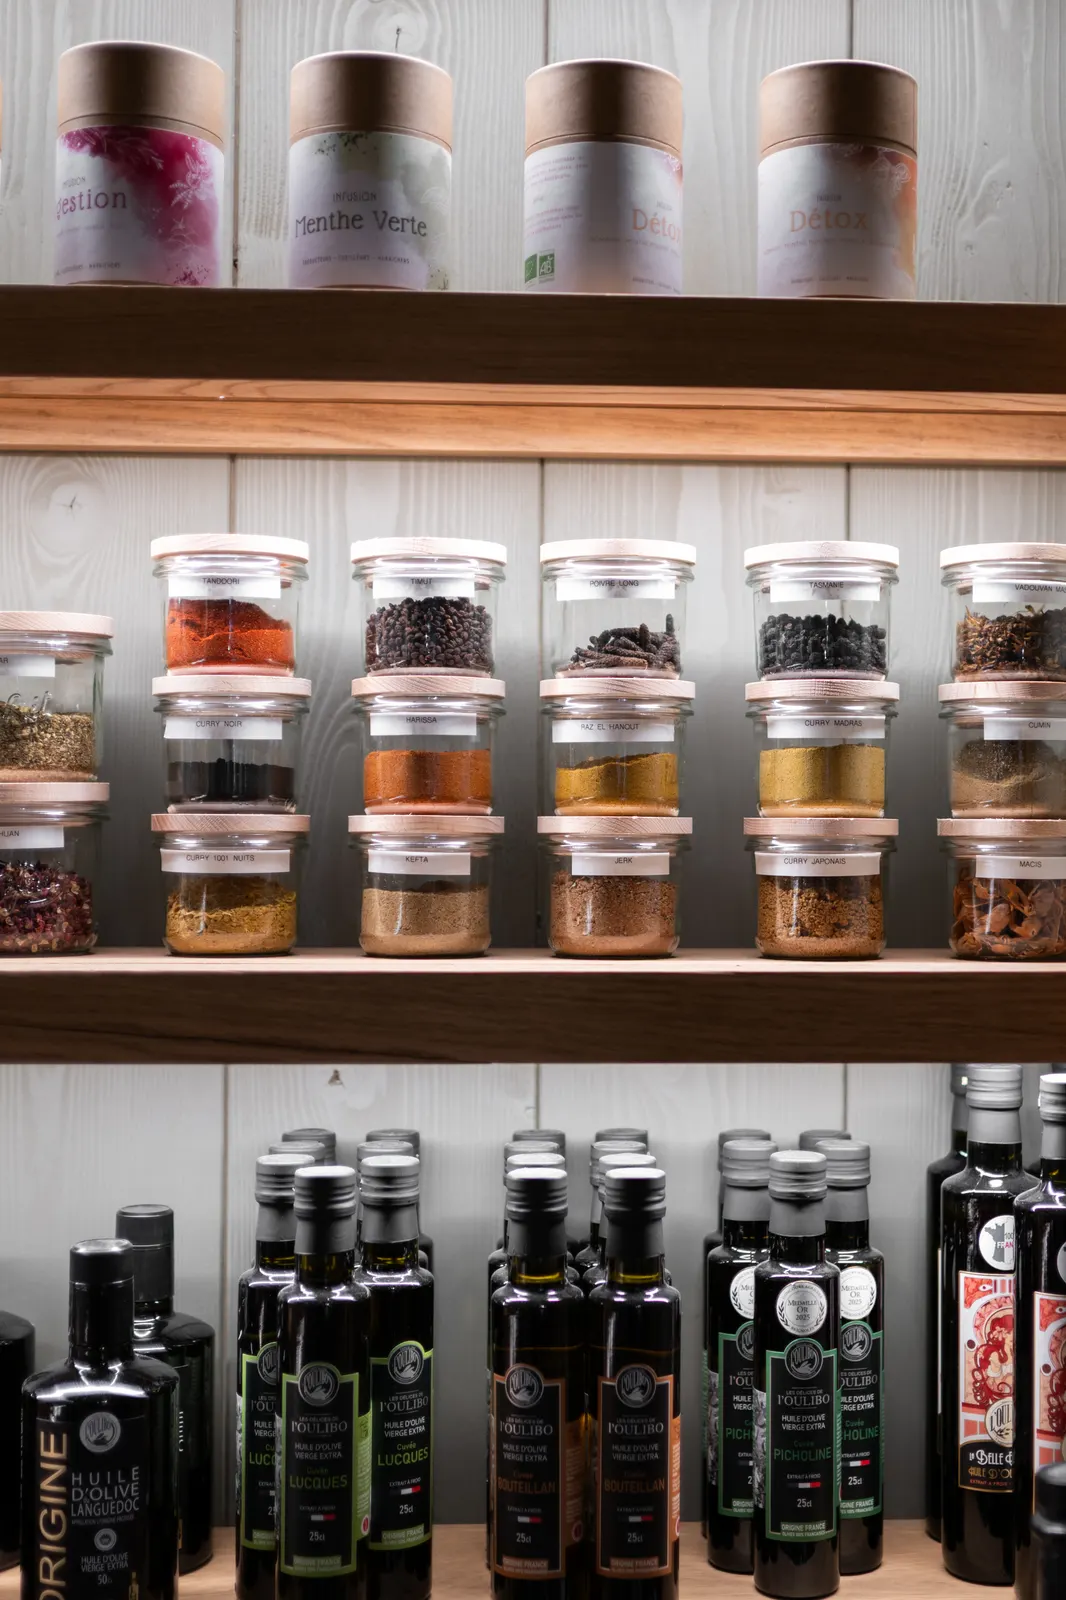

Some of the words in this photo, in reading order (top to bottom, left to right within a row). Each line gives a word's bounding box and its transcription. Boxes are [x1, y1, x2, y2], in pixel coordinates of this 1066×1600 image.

[295, 210, 364, 238] Menthe
[372, 210, 427, 238] Verte
[790, 207, 869, 233] Détox
[590, 579, 615, 587] POIVRE
[619, 579, 639, 587] LONG
[1015, 583, 1053, 592] VADOUVAN
[196, 720, 220, 728] CURRY
[224, 720, 242, 728] NOIR
[406, 716, 437, 724] HARISSA
[804, 719, 830, 727] CURRY
[834, 719, 863, 727] MADRAS
[1028, 721, 1051, 729] CUMIN
[597, 723, 606, 731] EL
[609, 723, 640, 731] HANOUT
[186, 854, 209, 862] CURRY
[213, 854, 229, 862] 1001
[233, 854, 255, 862] NUITS
[784, 857, 807, 865] CURRY
[811, 857, 846, 865] JAPONAIS
[1019, 860, 1042, 868] MACIS
[841, 1374, 878, 1387] OULIBO
[777, 1393, 830, 1406] l'OULIBO
[853, 1393, 875, 1403] D'OLIVE
[380, 1396, 428, 1412] l'OULIBO
[733, 1403, 753, 1411] VIERG
[841, 1403, 856, 1411] ERGE
[857, 1401, 875, 1411] EXTRA
[384, 1421, 404, 1430] HUILE
[405, 1416, 425, 1428] D'OLIVE
[781, 1414, 801, 1422] HUILE
[802, 1413, 826, 1422] D'OLIVE
[384, 1429, 408, 1438] VIERGE
[408, 1425, 425, 1436] EXTRA
[500, 1420, 553, 1436] l'OULIBO
[608, 1421, 664, 1436] l'OULIBO
[781, 1423, 805, 1431] VIERGE
[806, 1422, 826, 1431] EXTRA
[843, 1425, 879, 1441] HOLINE
[295, 1442, 313, 1451] HUILE
[315, 1441, 343, 1450] D'OLIVE
[396, 1441, 417, 1451] Cuvée
[502, 1443, 519, 1452] HUILE
[521, 1444, 548, 1454] D'OLIVE
[633, 1443, 659, 1452] D'OLIVE
[295, 1451, 318, 1460] VIERGE
[320, 1451, 342, 1460] EXTRA
[377, 1446, 429, 1466] LUCQUES
[503, 1452, 524, 1462] VIERGE
[525, 1454, 548, 1463] EXTRA
[612, 1452, 635, 1461] VIERGE
[637, 1452, 659, 1461] EXTRA
[773, 1446, 832, 1462] PICHOLINE
[72, 1466, 140, 1486] HUILE
[848, 1476, 863, 1486] 25cl
[289, 1475, 348, 1490] LUCQUES
[498, 1476, 556, 1494] BOUTEILLAN
[603, 1478, 665, 1493] BOUTEILLAN
[71, 1482, 140, 1501] D'OLIVE
[71, 1497, 140, 1517] LANGUEDOC
[796, 1498, 812, 1508] 25cl
[840, 1501, 854, 1509] IGINE
[855, 1498, 874, 1508] FRANCE
[38, 1430, 68, 1600] RIGINE
[399, 1504, 414, 1515] 25cl
[781, 1523, 804, 1532] ORIGINE
[805, 1522, 826, 1531] FRANCE
[309, 1531, 325, 1542] 25cl
[516, 1532, 532, 1543] 25cl
[627, 1532, 643, 1543] 25cl
[81, 1555, 101, 1564] HUILE
[102, 1552, 128, 1563] D'OLIVE
[81, 1563, 105, 1572] VIERGE
[107, 1560, 128, 1570] EXTRA
